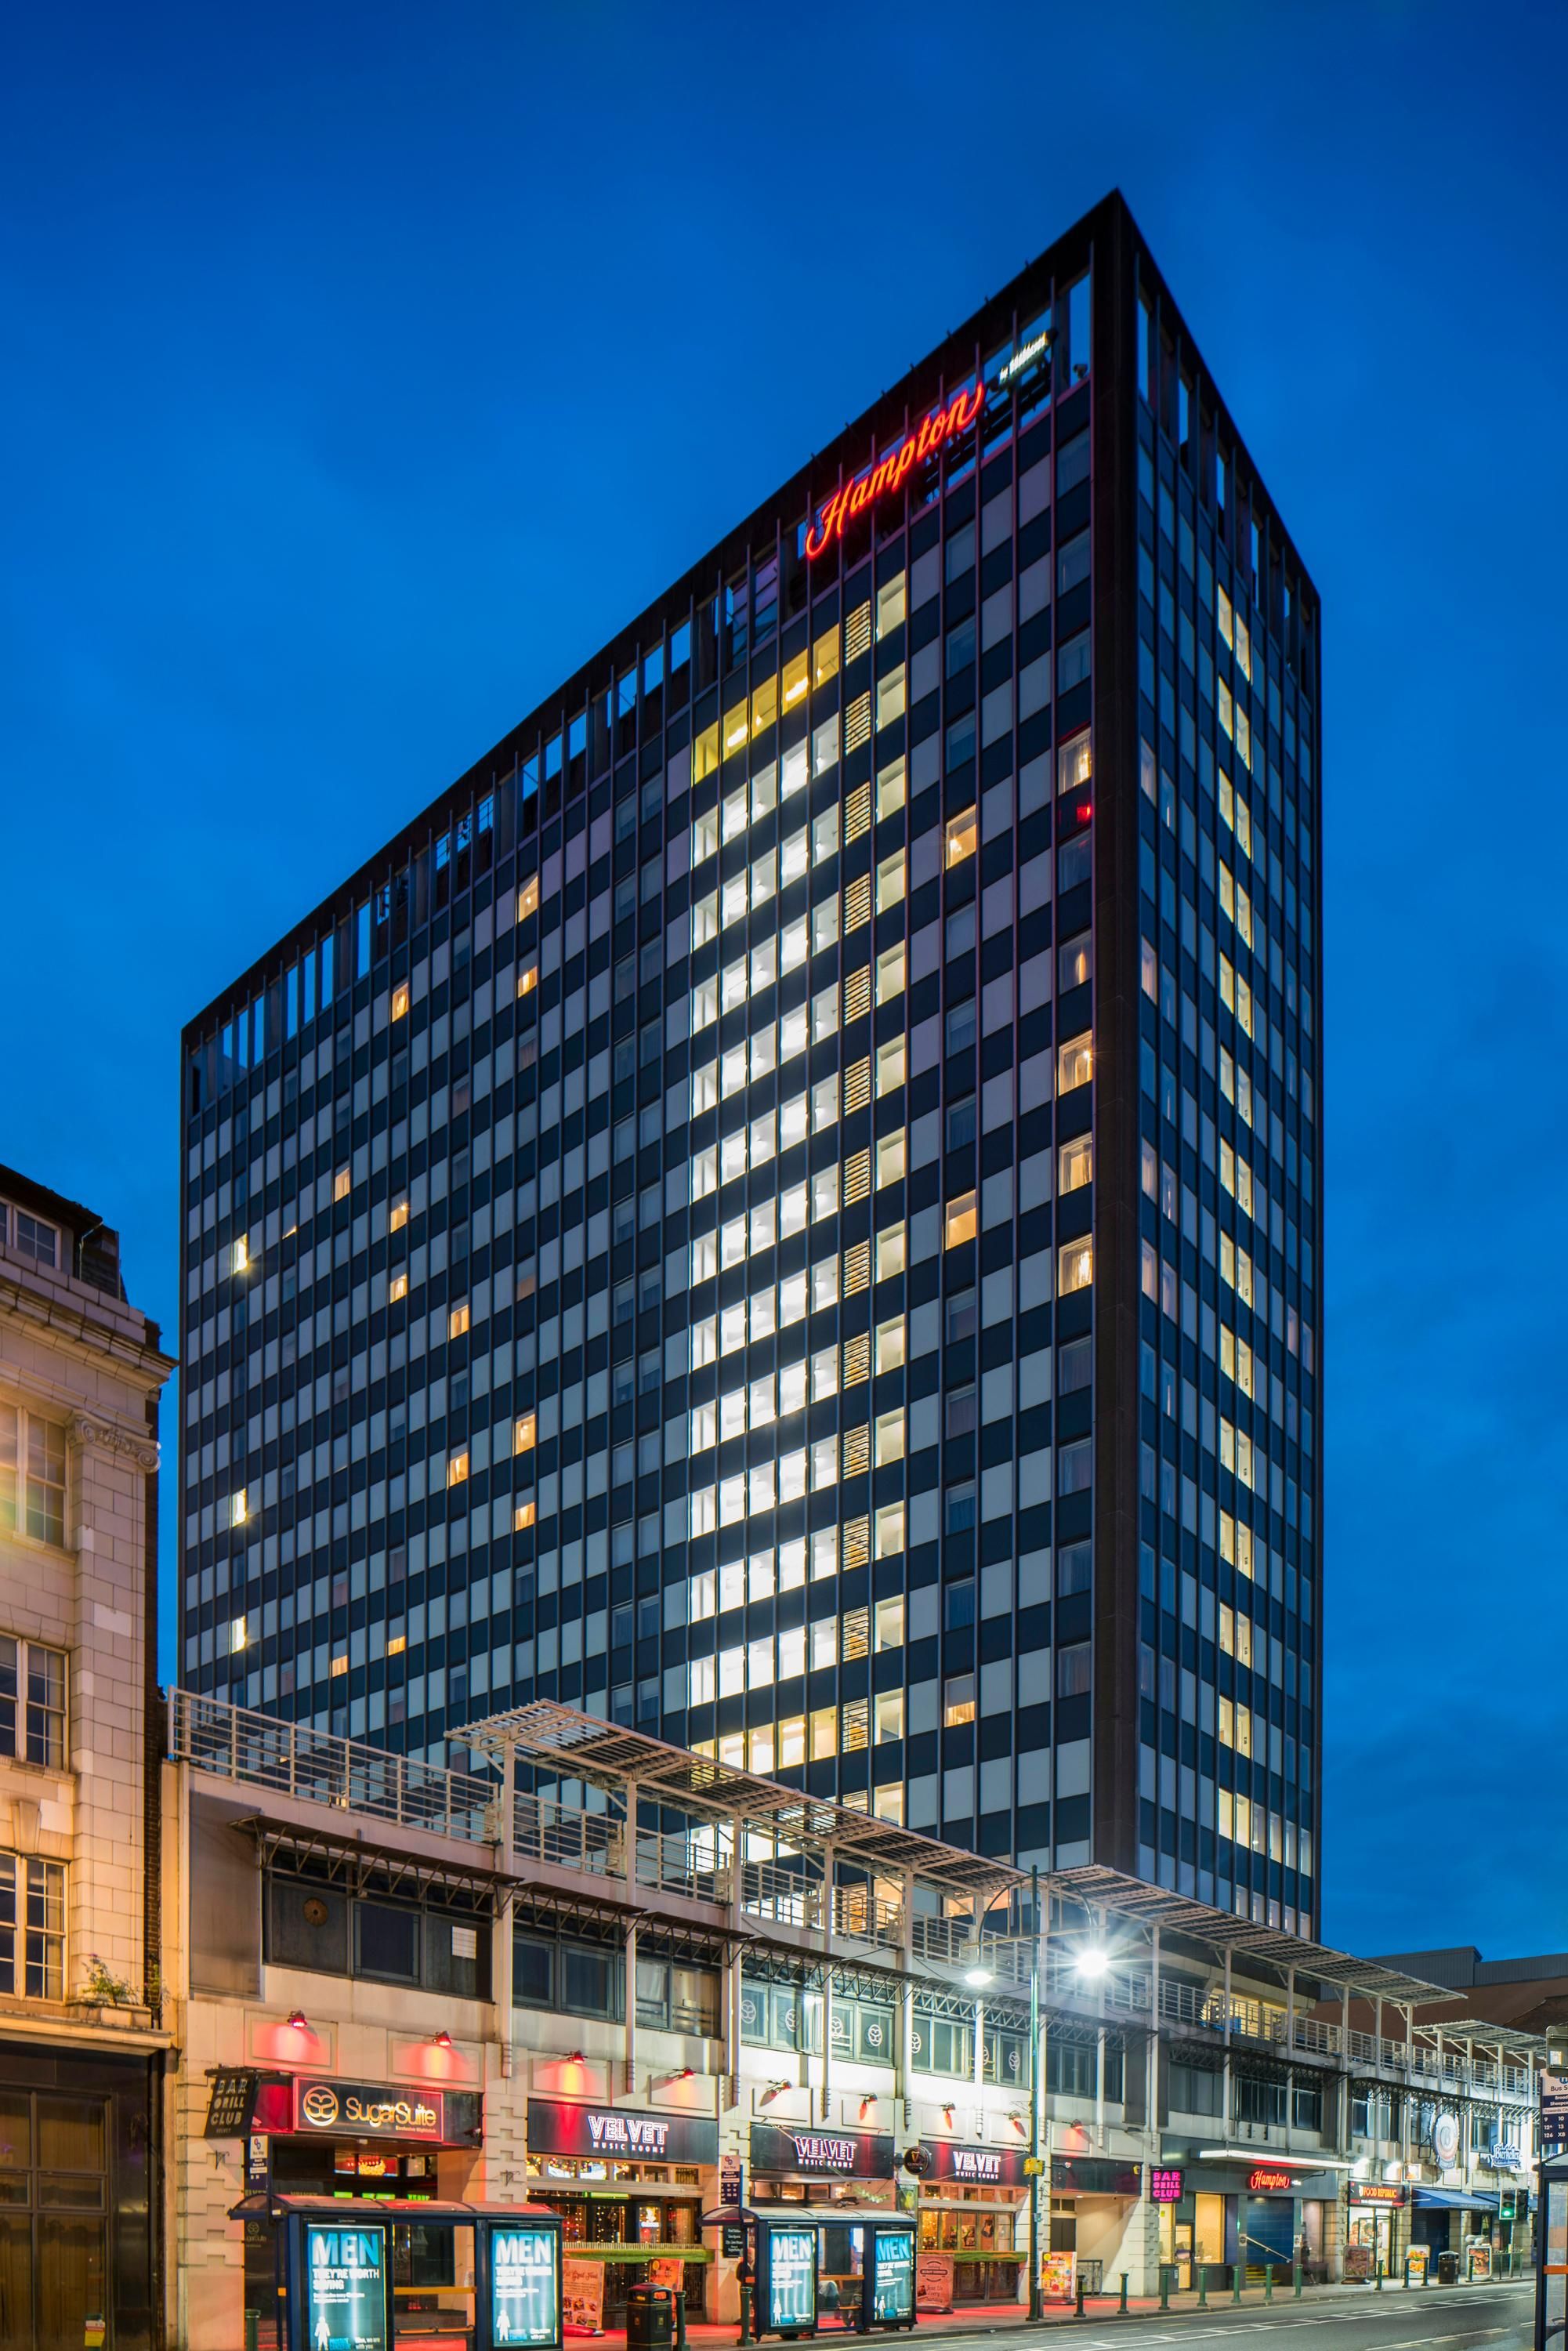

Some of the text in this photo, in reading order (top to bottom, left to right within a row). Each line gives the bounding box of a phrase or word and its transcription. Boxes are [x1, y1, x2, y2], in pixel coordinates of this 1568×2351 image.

[805, 381, 983, 560] Hampton
[216, 2078, 248, 2095] BAR
[210, 2111, 242, 2125] CLUB
[346, 2097, 436, 2128] SugarSuite
[588, 2116, 668, 2145] VELVET
[592, 2142, 665, 2154] MUSIC ROOMS
[794, 2136, 857, 2161] VELVET
[798, 2158, 853, 2168] MUSIC ROOMS
[953, 2151, 1001, 2173] VELVET
[1153, 2171, 1181, 2181] BAR
[1251, 2170, 1290, 2190] Hampton
[1363, 2186, 1397, 2199] FOOD REPUBLIC
[311, 2233, 380, 2266] MEN
[494, 2234, 552, 2264] MEN
[772, 2236, 812, 2260] MEN
[876, 2237, 910, 2262] MEN
